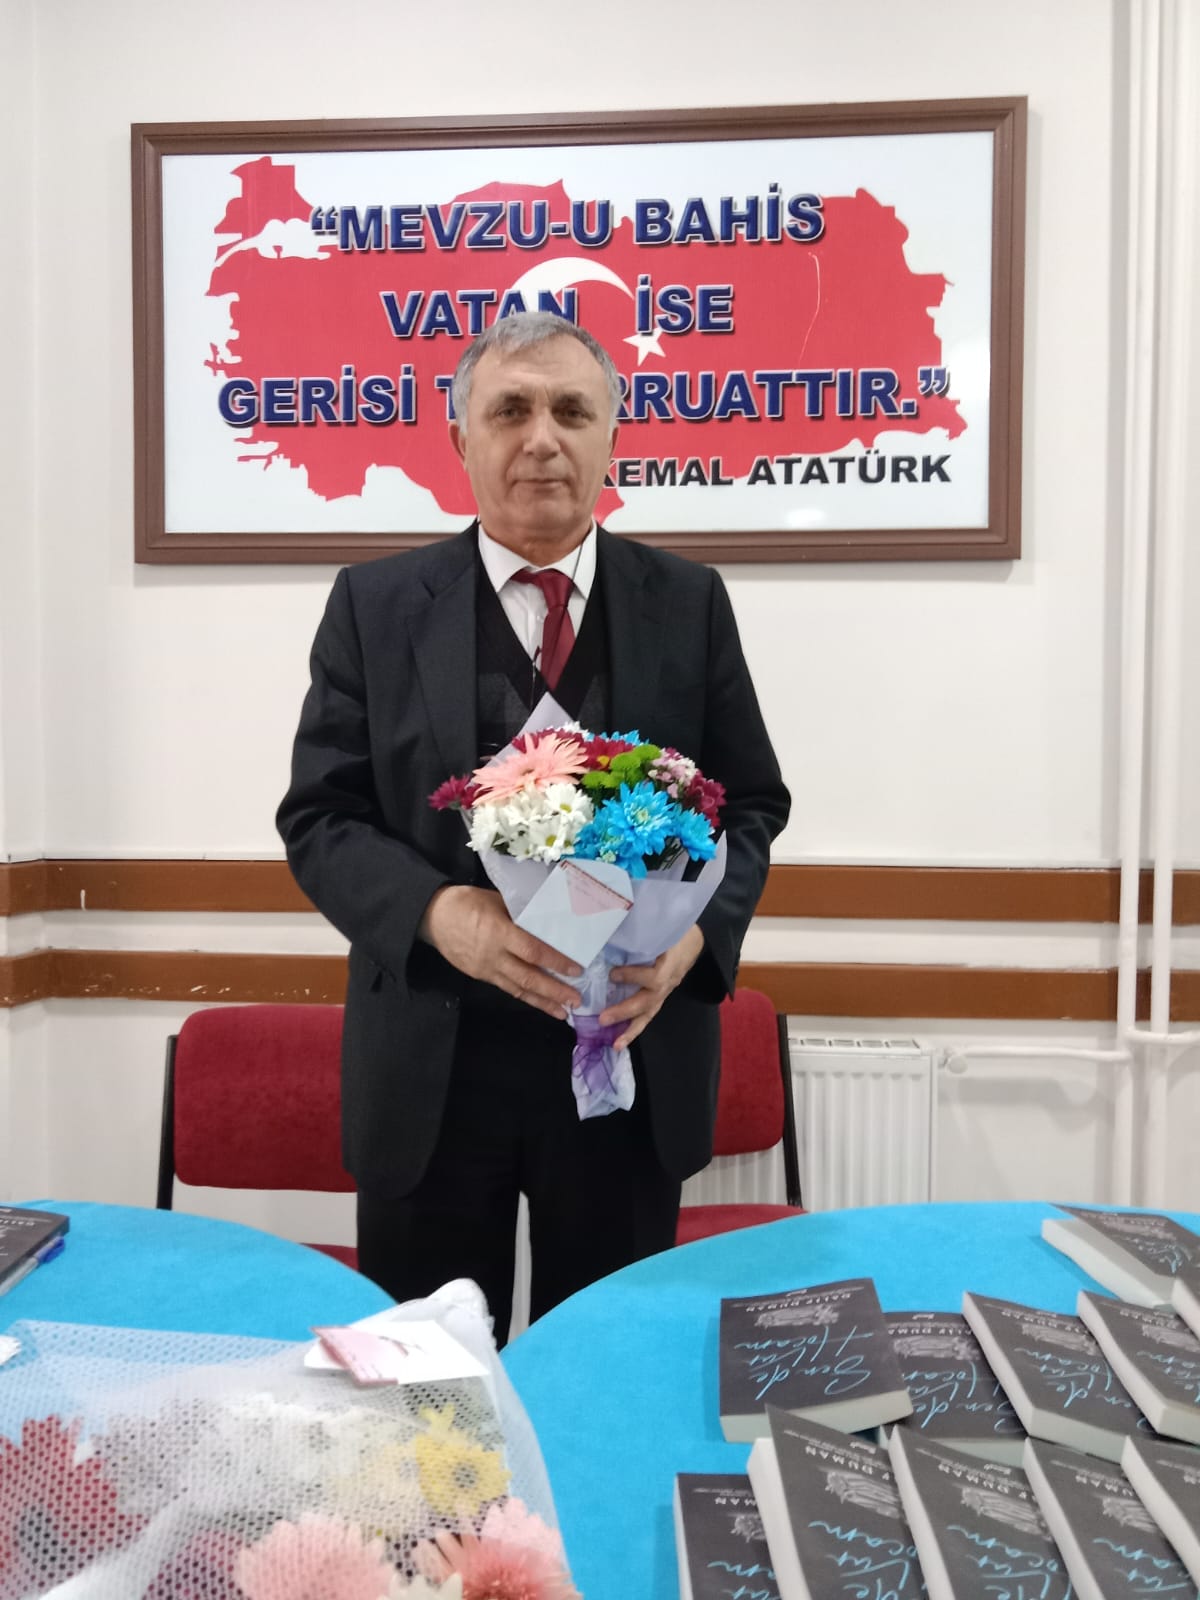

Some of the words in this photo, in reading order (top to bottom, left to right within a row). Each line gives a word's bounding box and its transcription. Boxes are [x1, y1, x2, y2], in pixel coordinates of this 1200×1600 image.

[310, 199, 613, 251] “MEVZU-U
[633, 182, 825, 244] BAHİS
[635, 274, 734, 335] İSE
[217, 365, 416, 426] GERİSİ
[747, 449, 951, 486] ATATÜRK
[749, 1365, 790, 1400] de
[797, 1354, 872, 1395] Sen
[804, 1445, 874, 1475] DUMAN
[1075, 1474, 1134, 1497] UMAN
[808, 1520, 918, 1558] ocam
